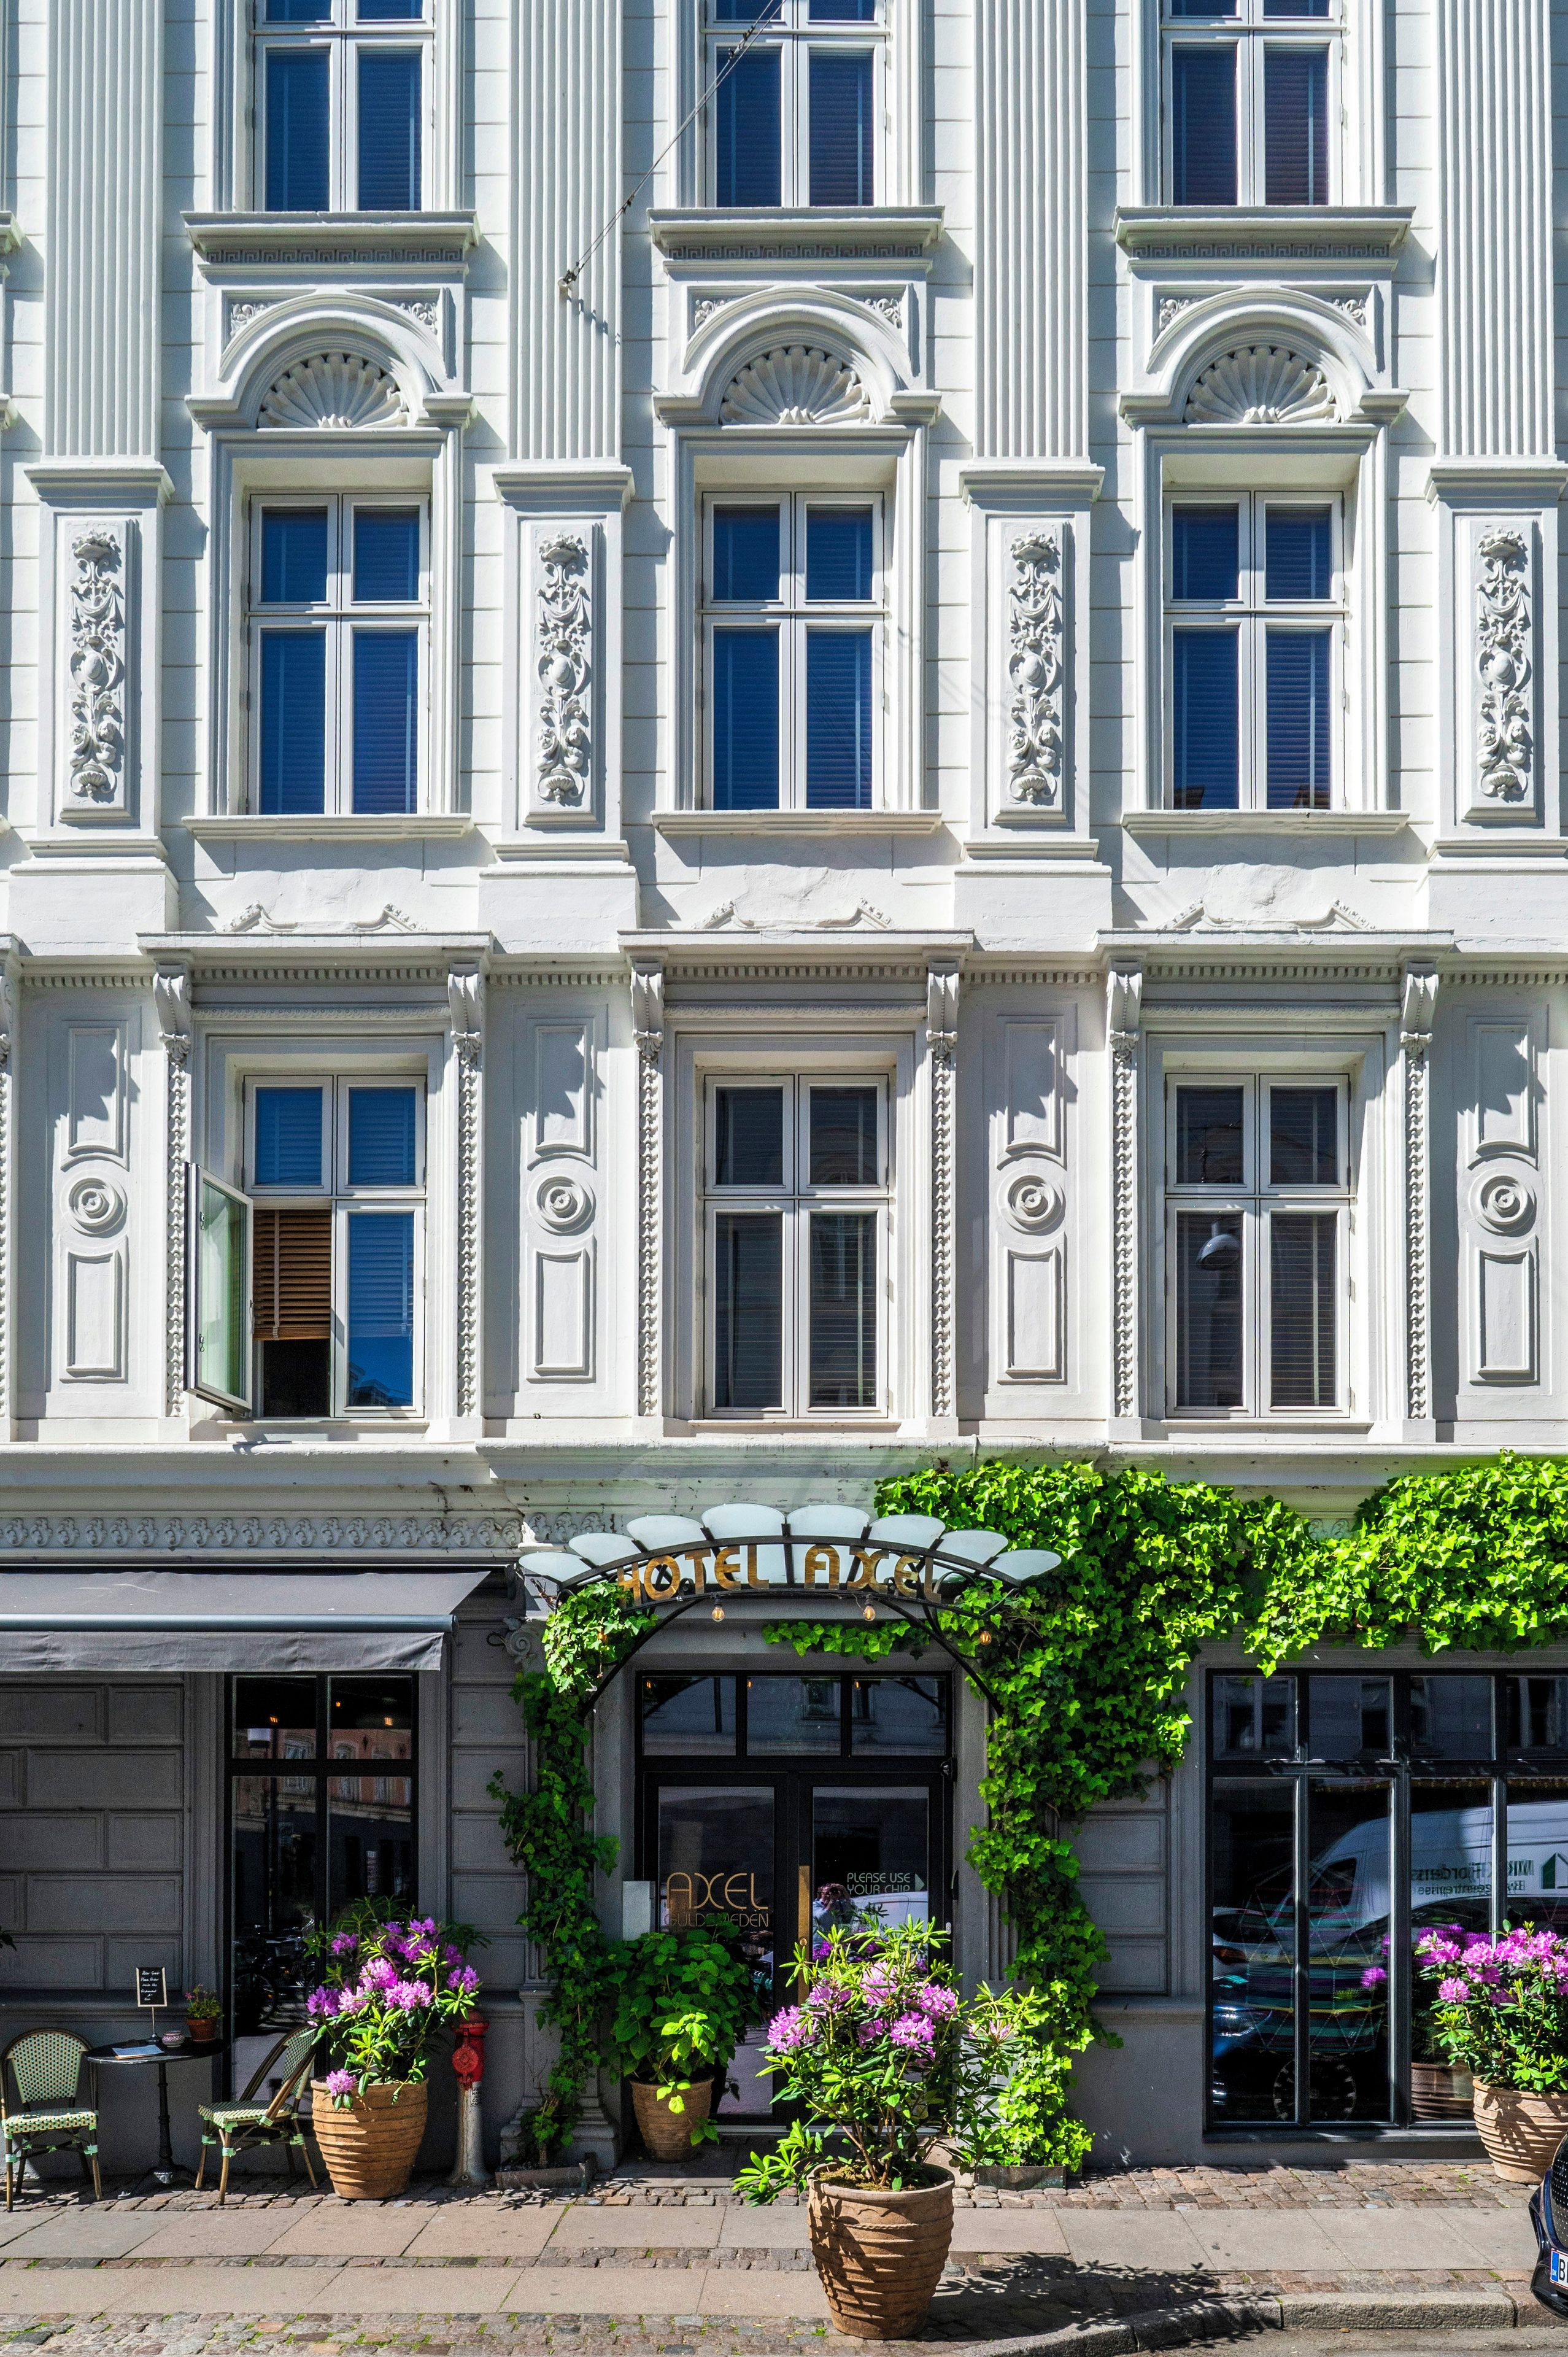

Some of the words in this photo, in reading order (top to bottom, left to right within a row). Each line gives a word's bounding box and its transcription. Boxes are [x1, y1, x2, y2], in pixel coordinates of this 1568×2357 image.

[617, 1544, 770, 1609] HOTEL
[803, 1544, 941, 1604] AXEL
[847, 1872, 886, 1883] PLEASE
[890, 1872, 911, 1883] USE
[847, 1884, 881, 1895] YOUR
[884, 1884, 910, 1894] CHIP
[666, 1872, 768, 1909] AXEL
[1559, 2258, 1568, 2283] B
